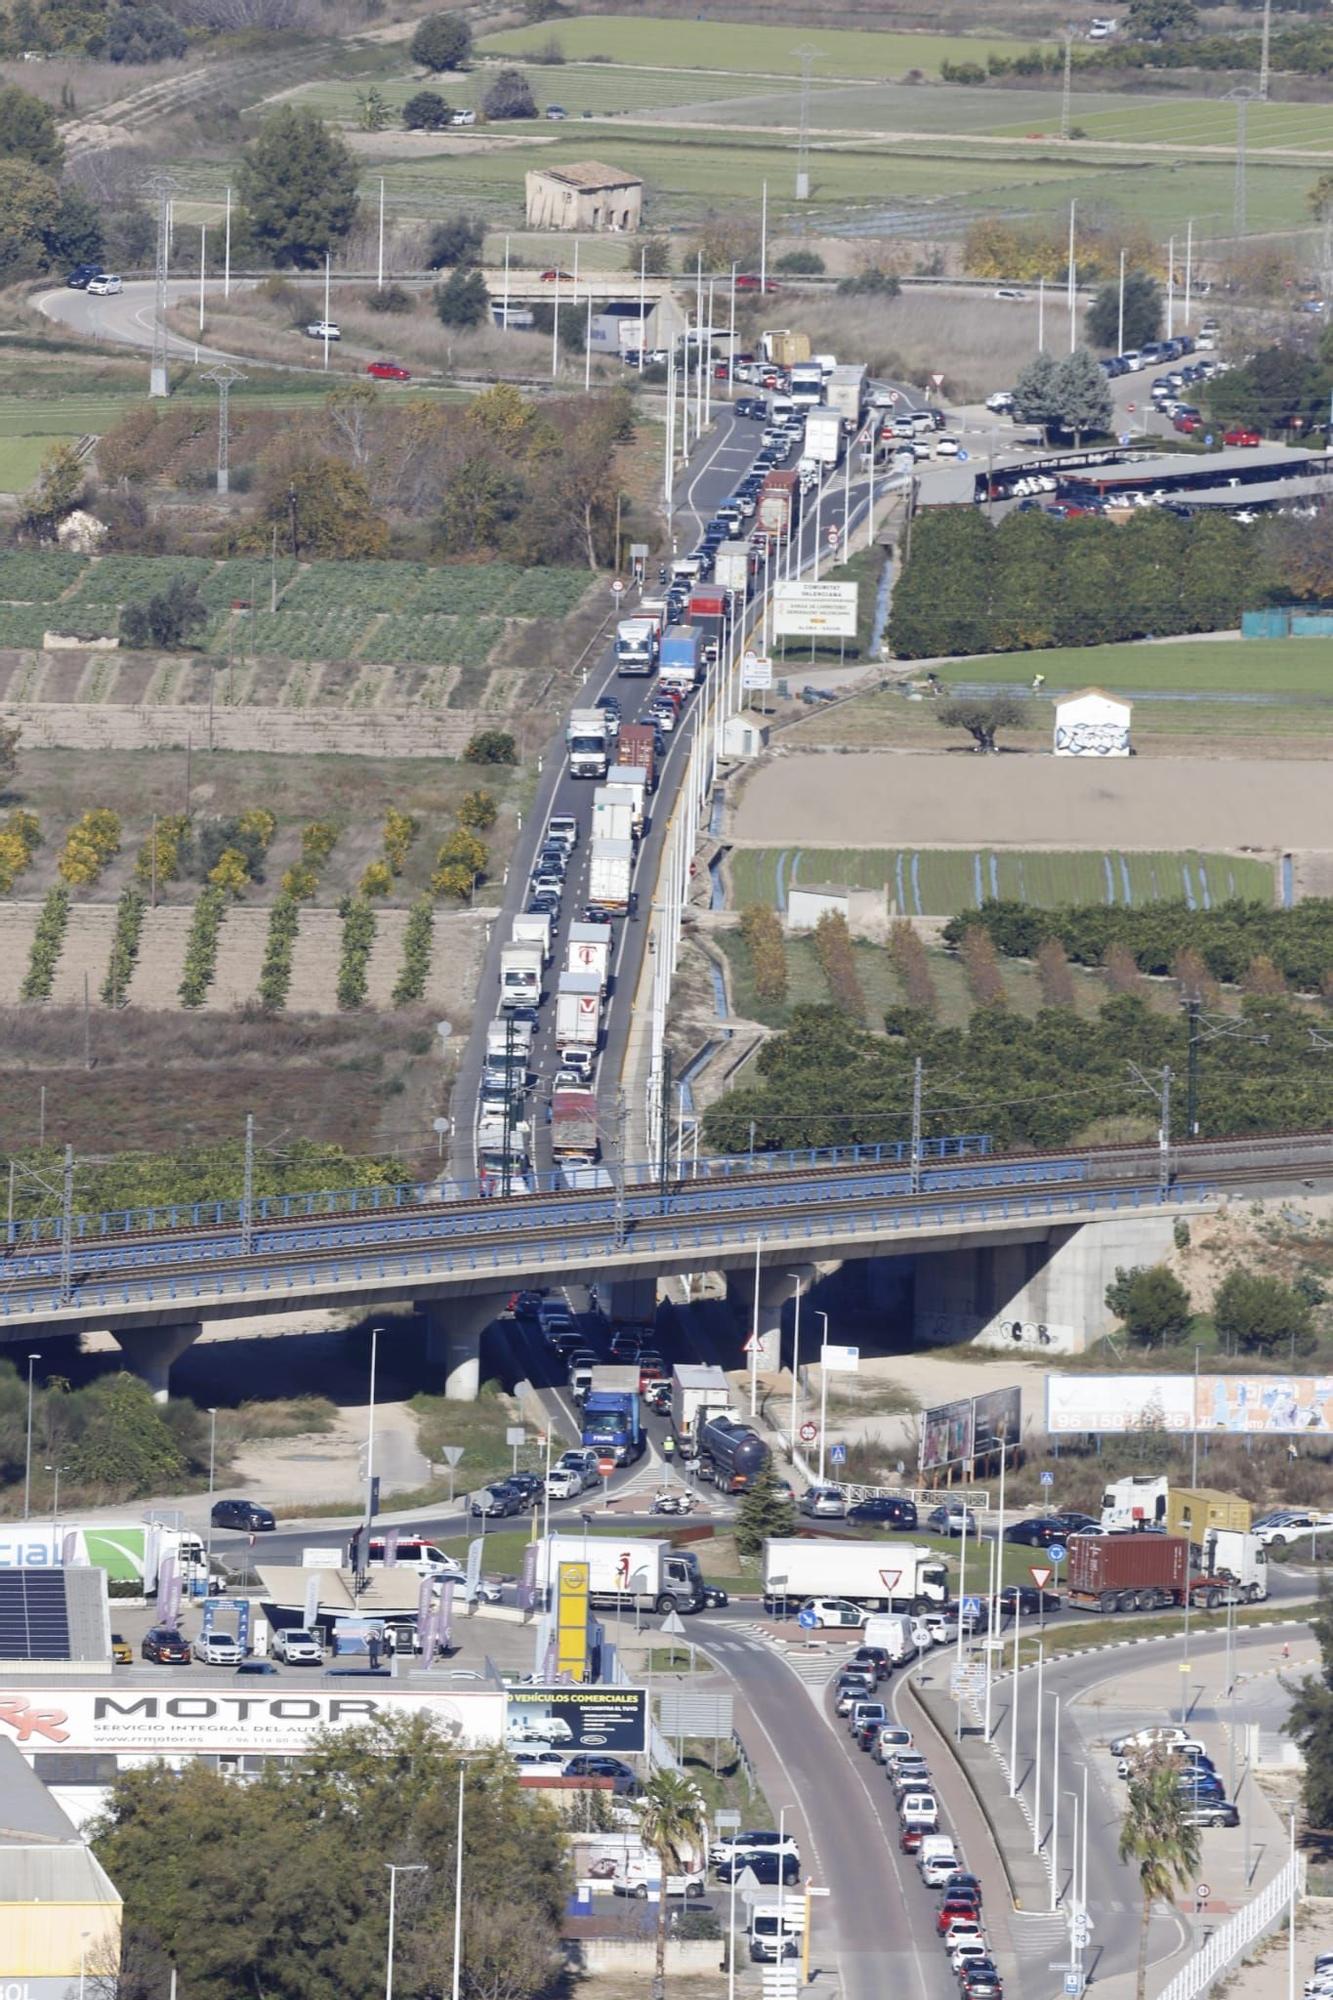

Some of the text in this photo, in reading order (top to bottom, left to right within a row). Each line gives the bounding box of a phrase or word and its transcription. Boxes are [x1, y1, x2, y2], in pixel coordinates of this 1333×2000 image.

[515, 1692, 570, 1703] VEHÍCULOS
[571, 1694, 639, 1703] COMERCIALES
[94, 1697, 380, 1722] MOTOR
[94, 1724, 165, 1732] SERVICIO
[171, 1724, 247, 1732] INTEGRAL
[253, 1725, 282, 1733] DEL
